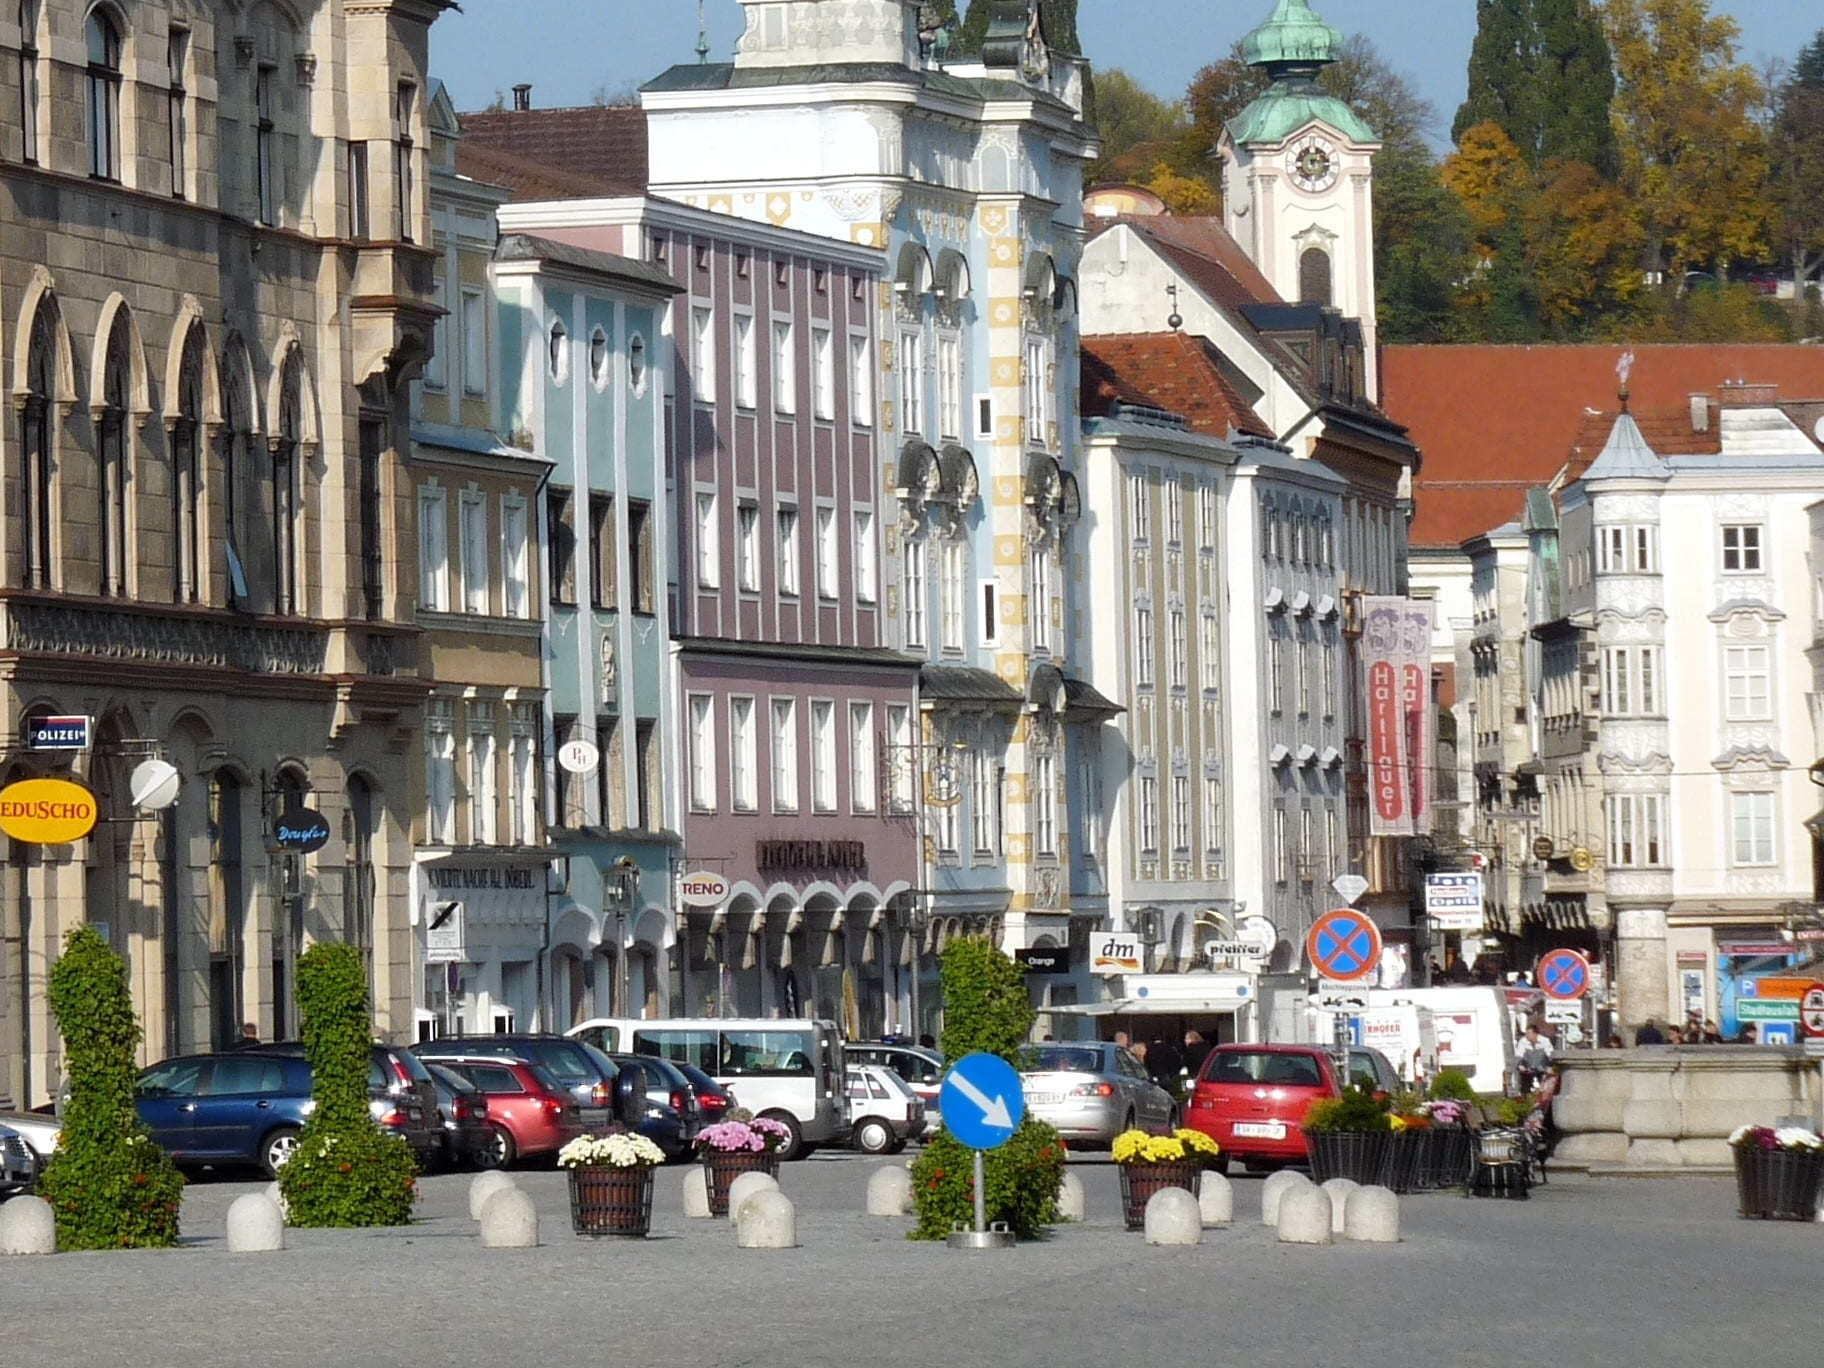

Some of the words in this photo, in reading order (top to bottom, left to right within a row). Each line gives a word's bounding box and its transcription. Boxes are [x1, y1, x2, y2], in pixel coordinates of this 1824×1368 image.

[31, 730, 79, 741] POLIZEI
[1375, 667, 1394, 815] Hartlauer
[0, 801, 91, 820] EDUSCHO
[682, 883, 724, 895] RENO
[1102, 938, 1134, 958] dm
[1210, 944, 1260, 955] pfeiffer
[1028, 957, 1055, 966] Orange
